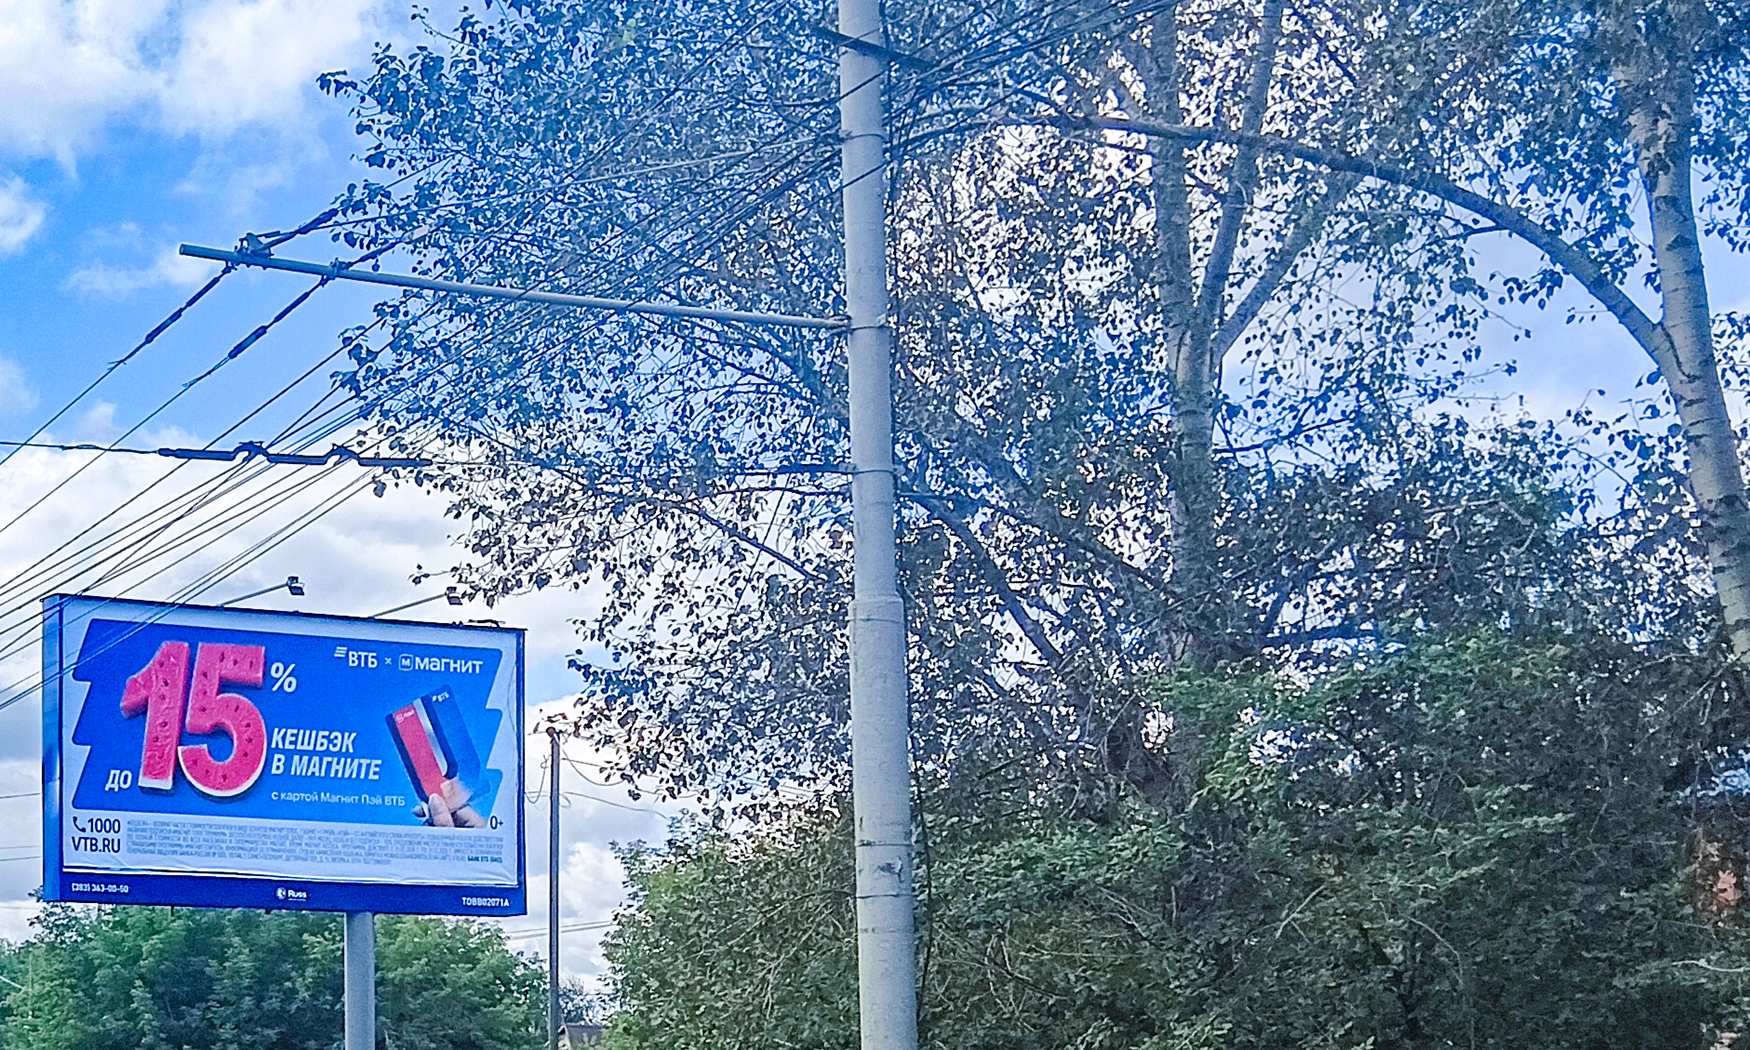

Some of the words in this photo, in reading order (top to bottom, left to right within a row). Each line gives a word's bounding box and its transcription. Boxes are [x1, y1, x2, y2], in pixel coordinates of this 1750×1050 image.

[348, 651, 378, 669] ВТБ
[120, 640, 268, 797] 15
[270, 662, 298, 693] %
[271, 727, 357, 753] КЕШБЭК
[271, 753, 286, 775] В
[290, 754, 382, 780] МАГНИТЕ
[105, 769, 132, 792] ДО
[271, 791, 279, 800] с
[280, 791, 319, 803] картой
[320, 791, 359, 804] Магнит
[361, 794, 382, 805] Пэй
[384, 796, 405, 806] ВТБ
[87, 817, 121, 834] 1000
[71, 836, 121, 853] VTB.RU
